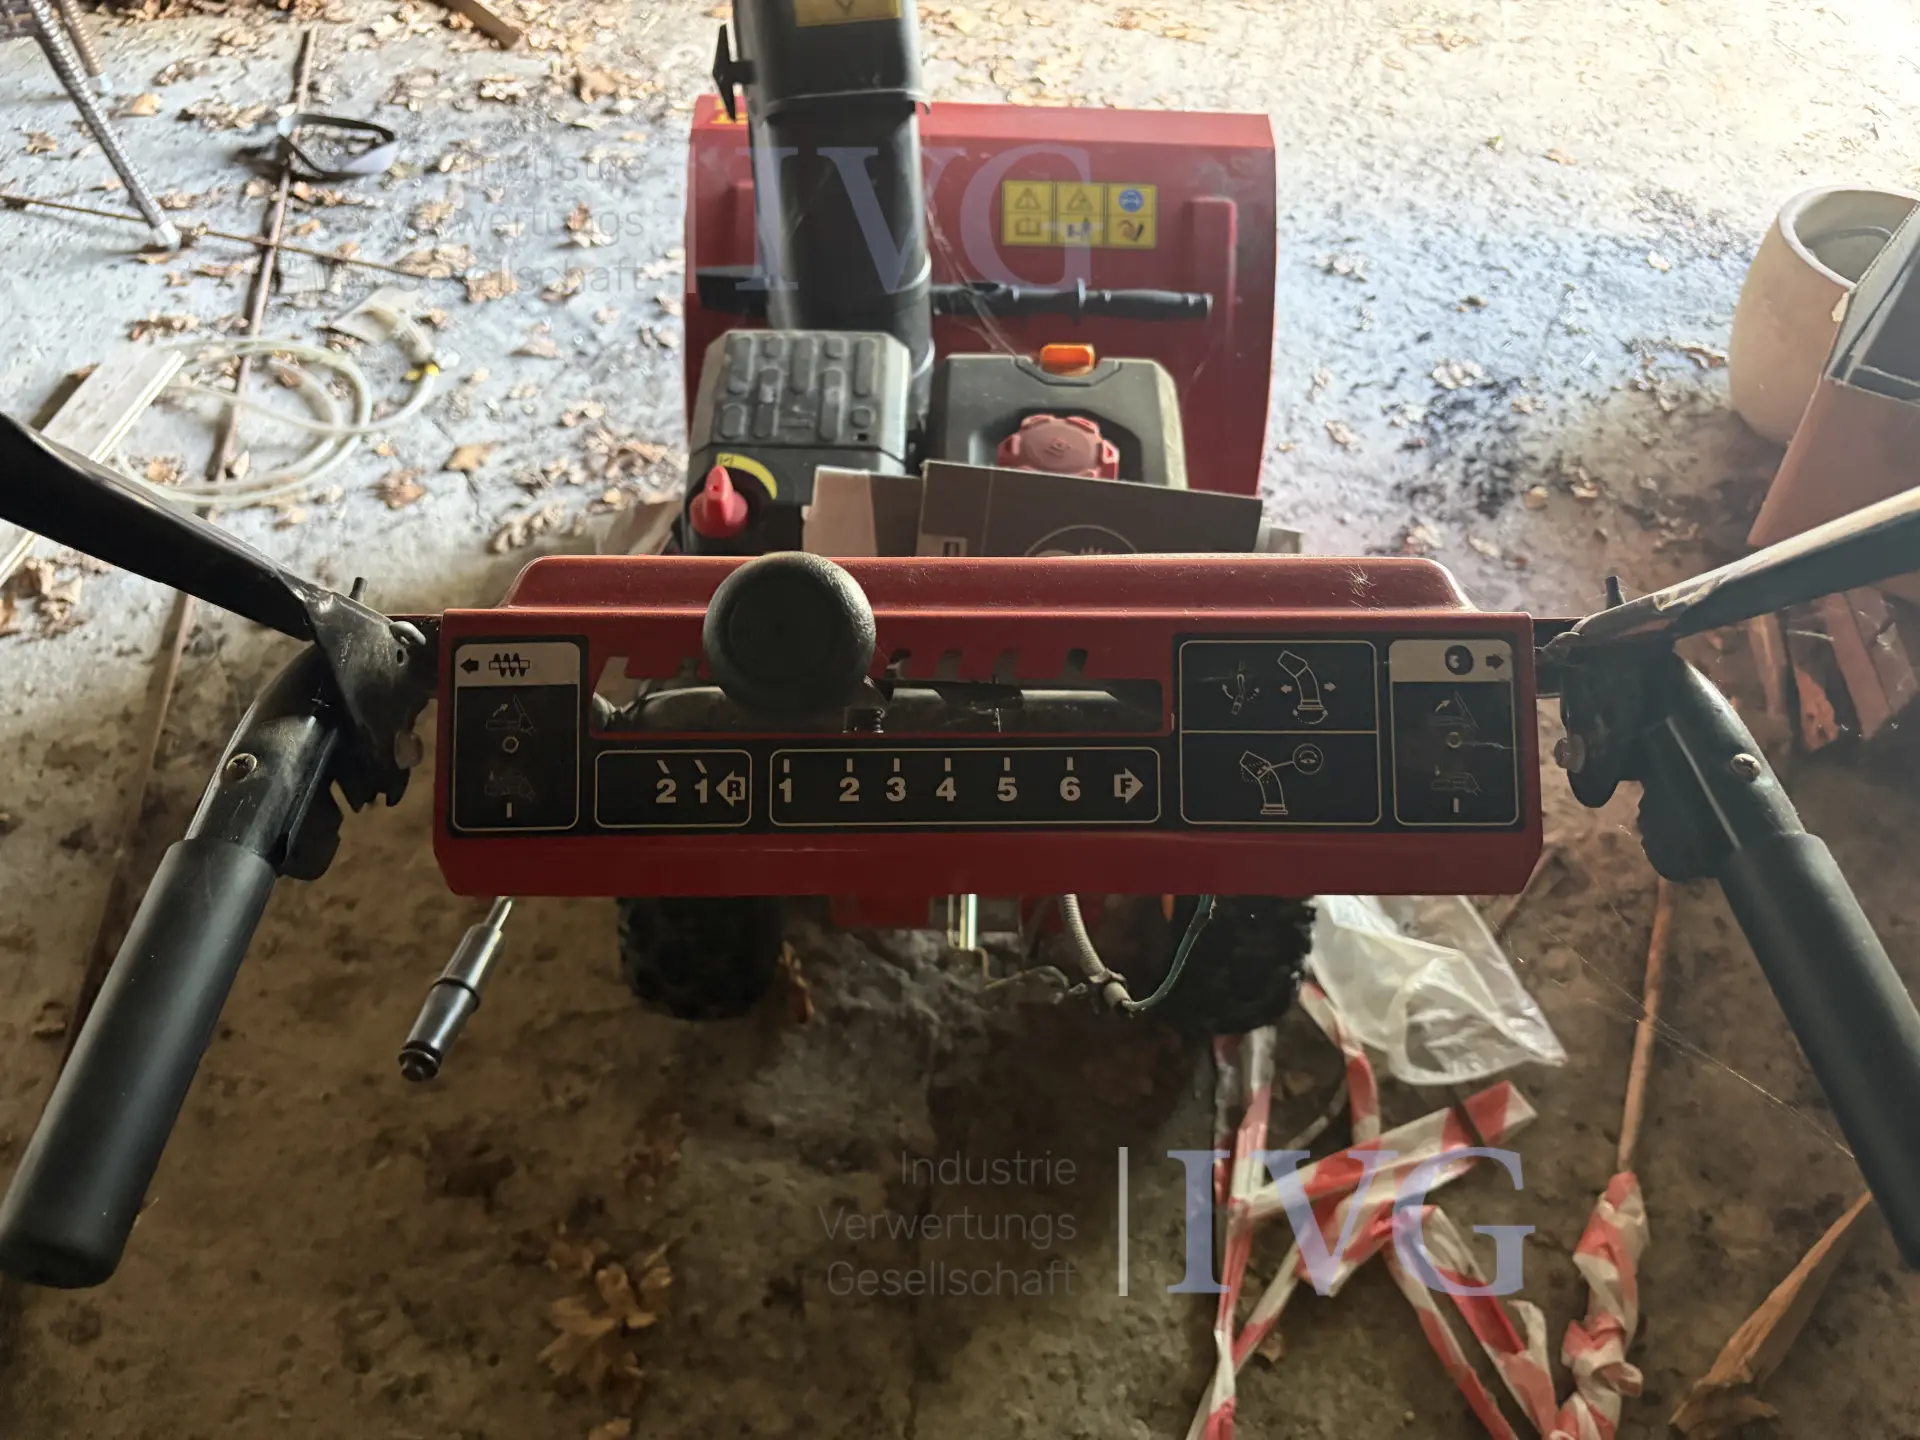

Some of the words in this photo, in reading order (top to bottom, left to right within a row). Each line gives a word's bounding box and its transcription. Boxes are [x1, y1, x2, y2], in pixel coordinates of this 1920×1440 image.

[655, 778, 677, 803] 2
[694, 778, 708, 803] 1
[778, 778, 792, 803] 1
[839, 777, 860, 802] 2
[885, 777, 906, 802] 3
[936, 777, 957, 802] 4
[997, 777, 1018, 802] 5
[1060, 777, 1081, 802] 6
